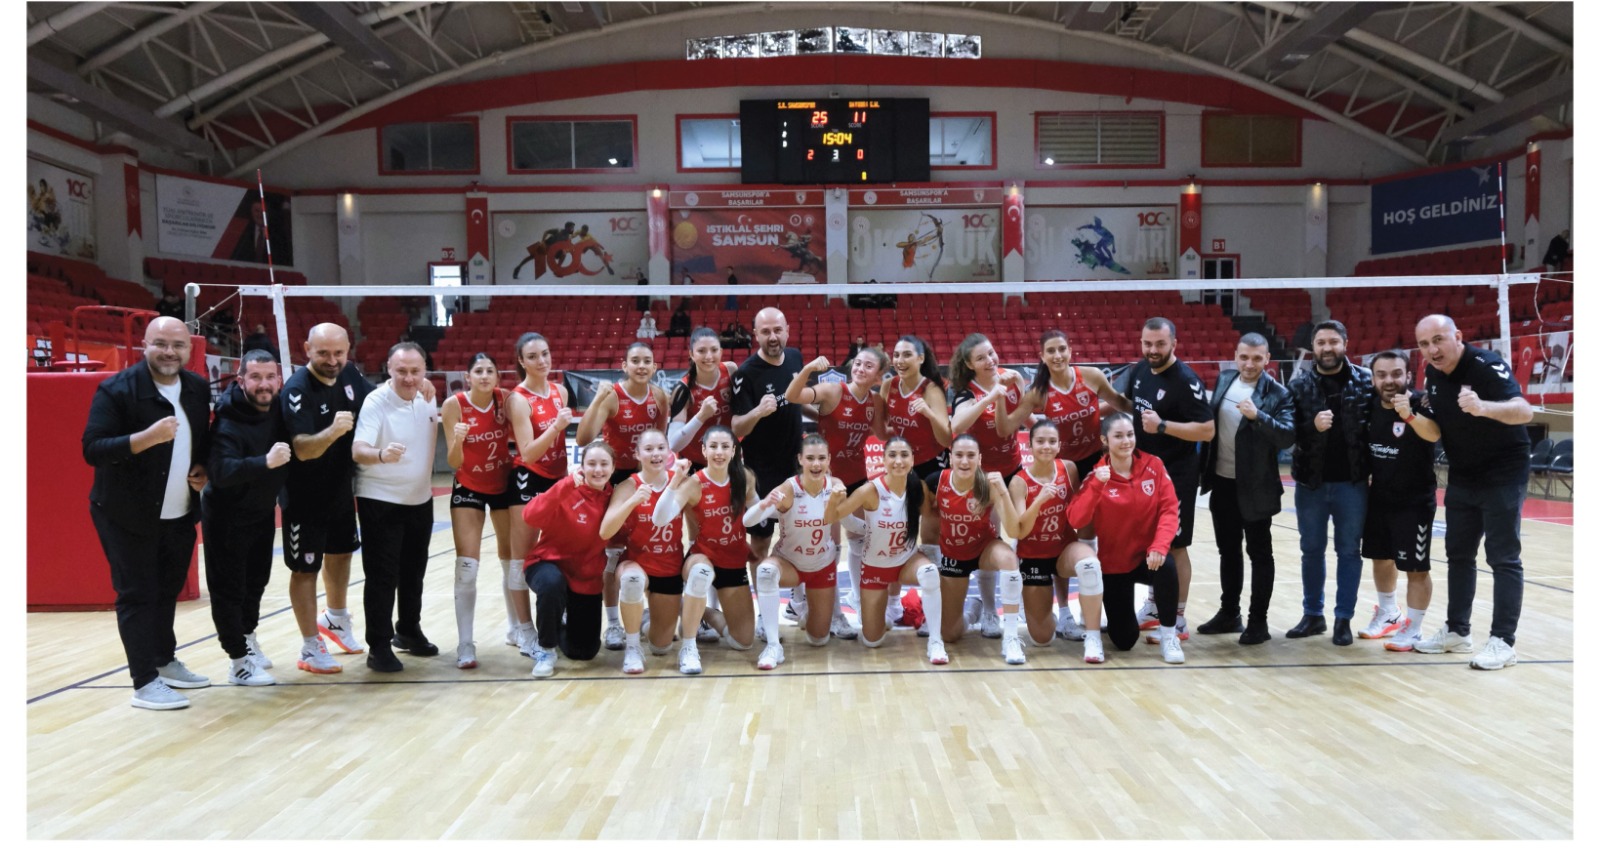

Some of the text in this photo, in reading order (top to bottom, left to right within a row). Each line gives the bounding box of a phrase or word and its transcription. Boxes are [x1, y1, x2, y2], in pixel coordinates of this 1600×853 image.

[812, 111, 866, 124] 25 11
[823, 132, 852, 145] 15:04
[807, 149, 814, 160] 2
[833, 149, 839, 160] 3
[1383, 193, 1498, 225] HOŞ GELDİNİZ
[712, 234, 779, 246] SAMSUN
[1213, 241, 1225, 250] B1
[442, 250, 455, 259] B2
[1135, 396, 1153, 410] SKODA
[889, 415, 919, 428] KODA
[1052, 406, 1096, 424] SKODA
[897, 426, 905, 437] 7
[1072, 421, 1083, 436] 6
[846, 432, 864, 447] 14
[487, 442, 498, 460] 2
[866, 444, 884, 452] VOL
[541, 449, 567, 462] ASA
[866, 456, 884, 464] ASY
[1021, 454, 1035, 463] YO
[704, 506, 733, 518] SKO
[1039, 503, 1067, 516] KOD
[940, 512, 981, 522] SKODA
[1041, 515, 1059, 532] 18
[722, 516, 732, 534] 8
[877, 520, 908, 529] SKO
[950, 523, 968, 537] 10
[649, 523, 673, 542] 26
[811, 529, 824, 545] 9
[888, 531, 907, 547] 16
